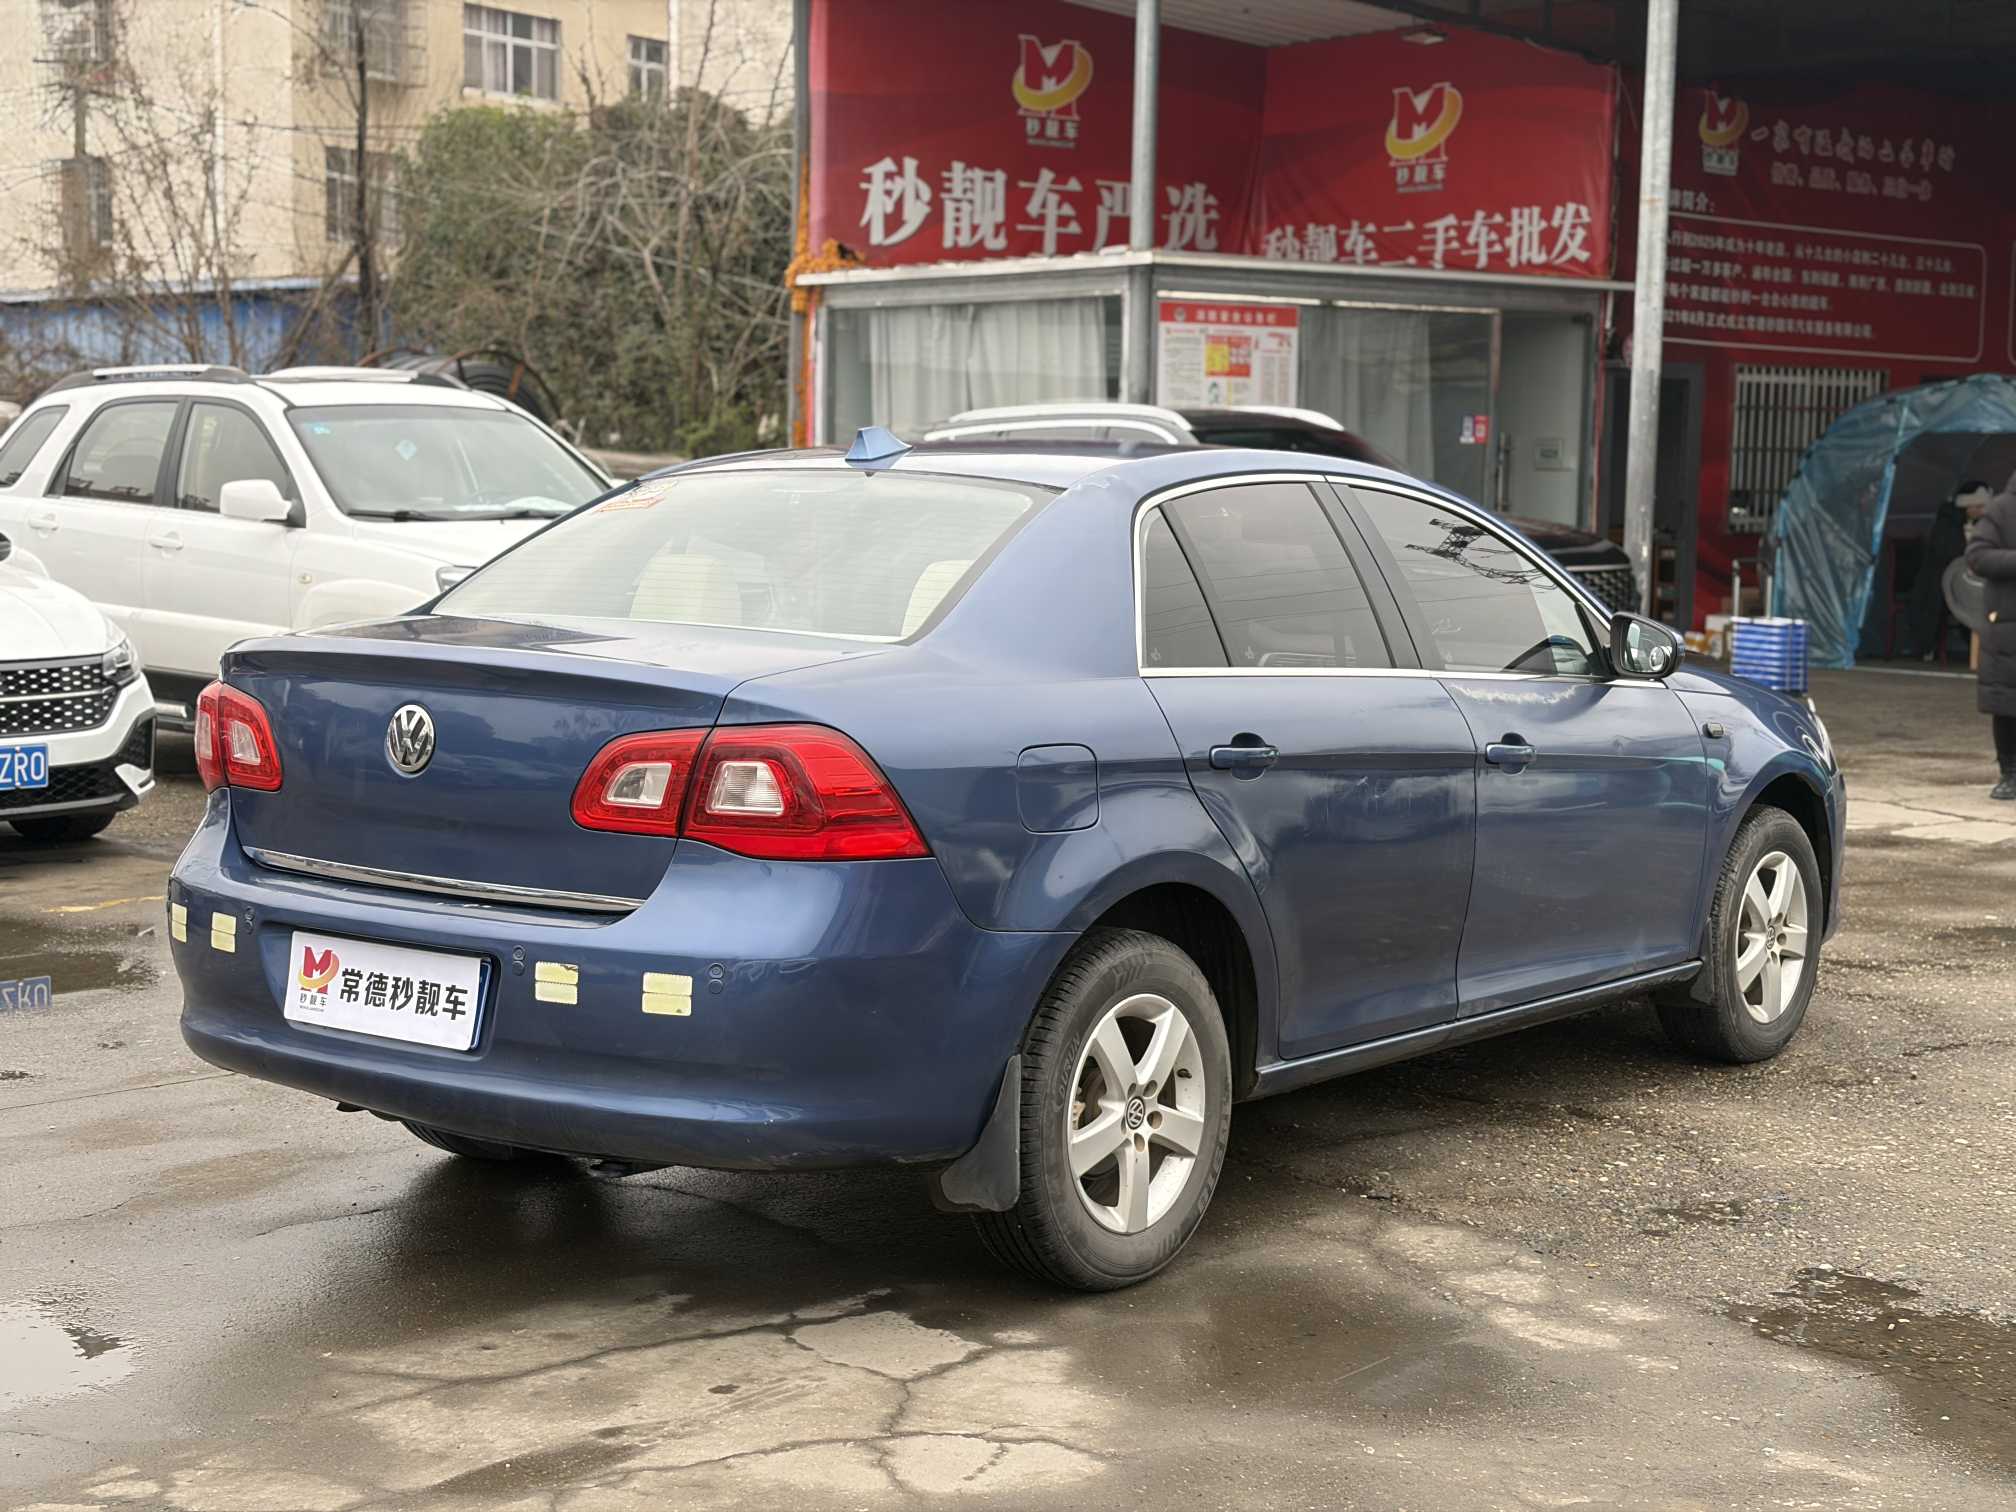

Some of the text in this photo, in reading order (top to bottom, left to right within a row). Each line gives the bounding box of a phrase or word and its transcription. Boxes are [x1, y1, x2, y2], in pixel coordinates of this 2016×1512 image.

[1263, 201, 1593, 271] 秒靓车二手车批发
[339, 967, 469, 1021] 常德秒靓车
